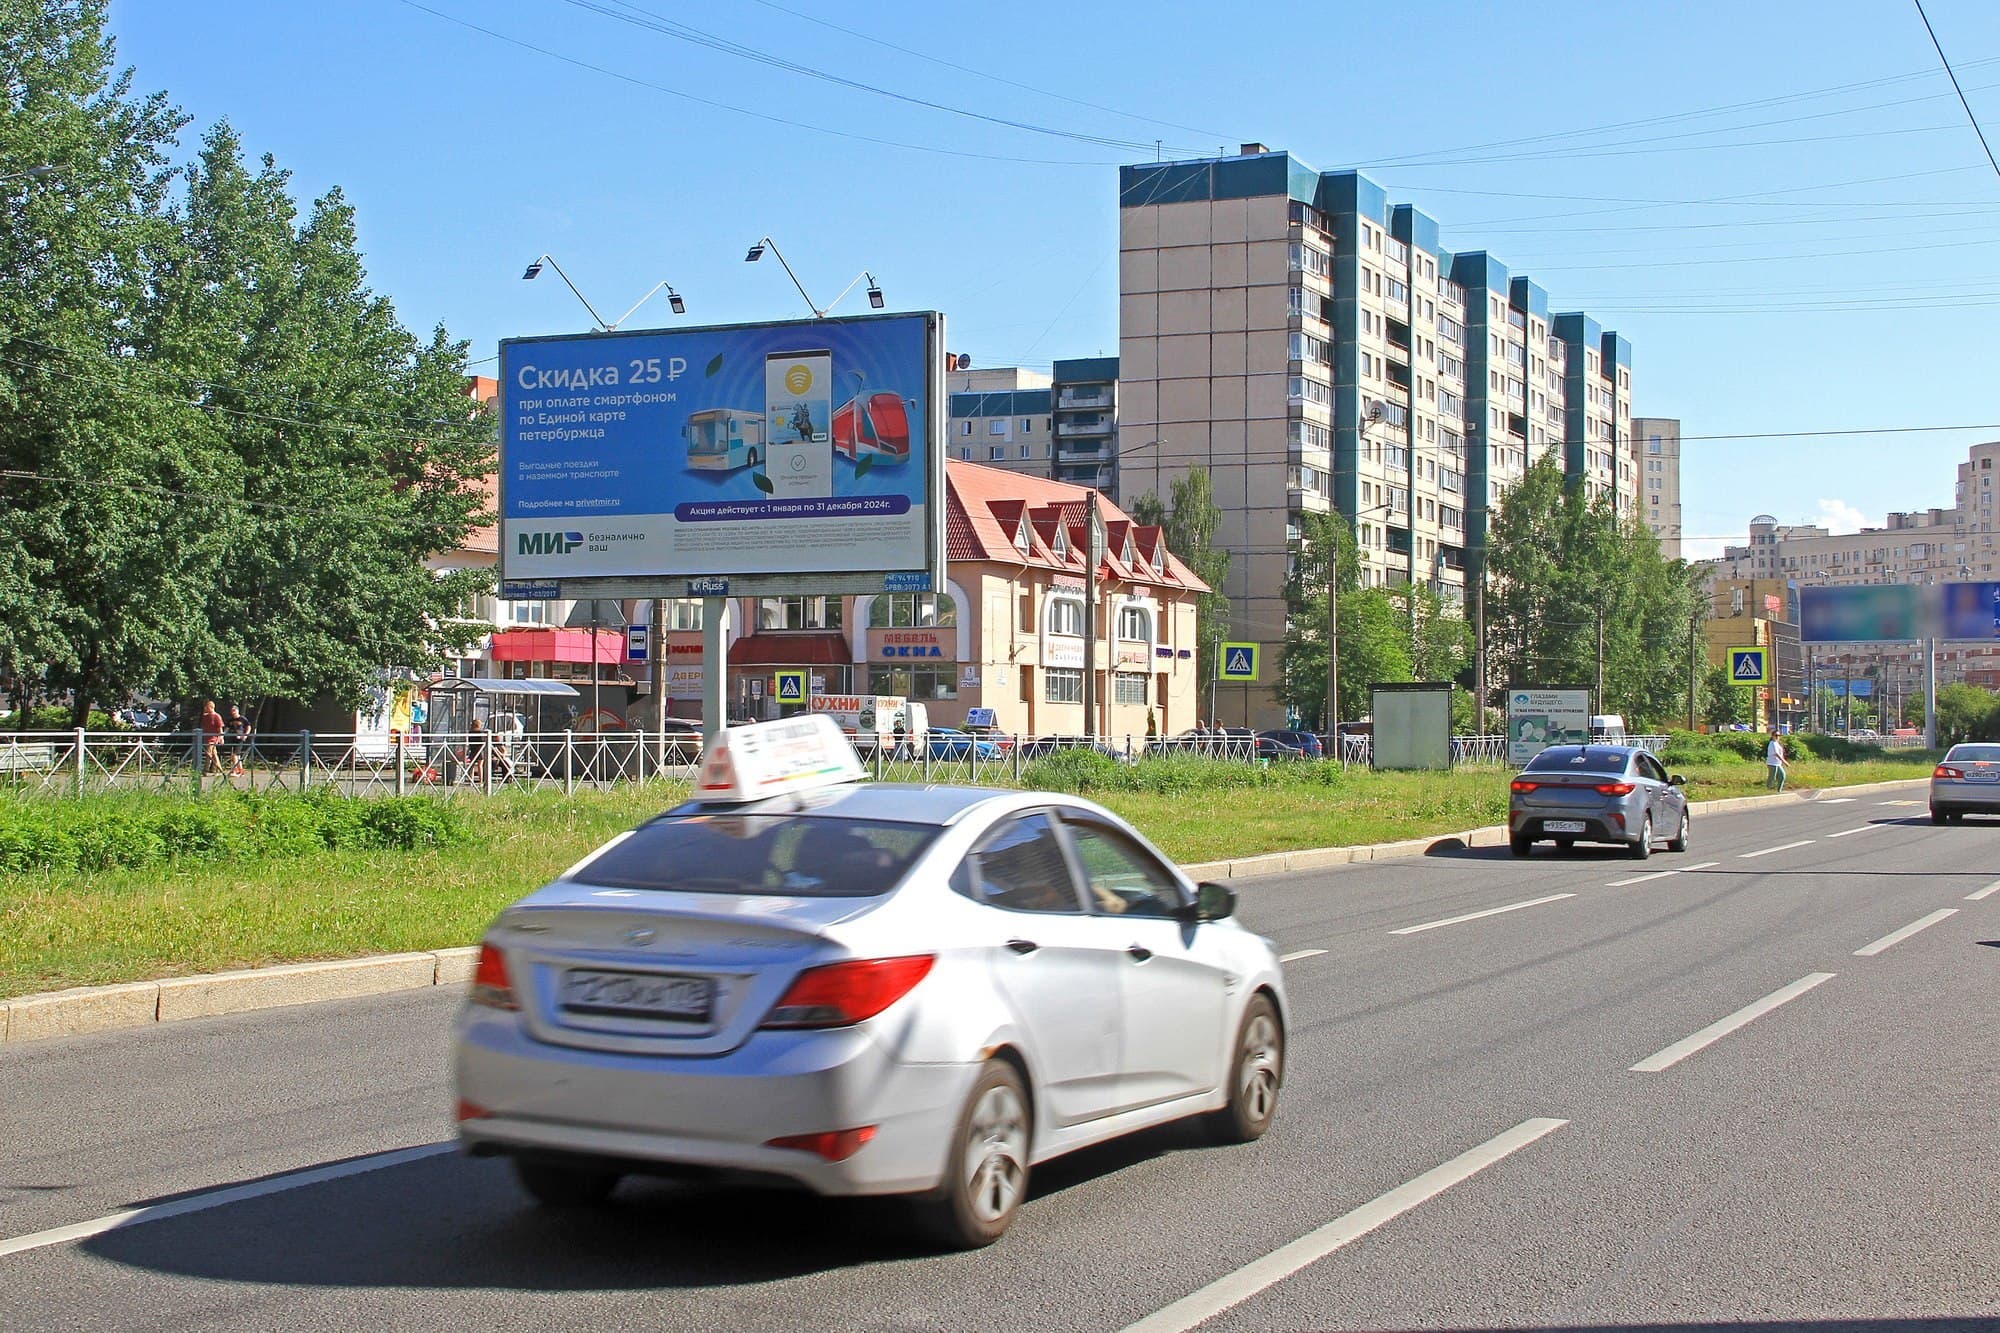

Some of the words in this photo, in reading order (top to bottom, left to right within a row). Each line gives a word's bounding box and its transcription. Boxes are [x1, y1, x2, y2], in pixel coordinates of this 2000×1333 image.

[518, 365, 619, 391] Скидка
[629, 358, 662, 385] 25
[519, 398, 543, 412] при
[546, 396, 590, 408] оплате
[594, 391, 677, 406] смартфоном
[519, 415, 535, 425] по
[539, 411, 586, 426] Единой
[589, 410, 627, 424] карте
[519, 427, 605, 442] петербуржца
[519, 461, 561, 470] Выгодные
[563, 460, 599, 469] поездки
[526, 472, 568, 481] наземном
[570, 470, 619, 479] транспорте
[518, 500, 563, 509] Подробнее
[575, 498, 620, 508] privetmir.ru
[690, 506, 716, 516] Акция
[717, 505, 759, 516] действует
[767, 503, 772, 512] 1
[772, 503, 803, 513] января
[803, 503, 815, 512] по
[816, 502, 826, 511] 31
[826, 501, 863, 512] декабря
[863, 500, 891, 510] 2024г.
[518, 531, 585, 555] МИР
[588, 532, 645, 542] безналично
[588, 543, 608, 552] ваш
[702, 581, 724, 591] Russ
[884, 633, 937, 644] МЕБЕЛЬ
[882, 646, 942, 657] ОКНА
